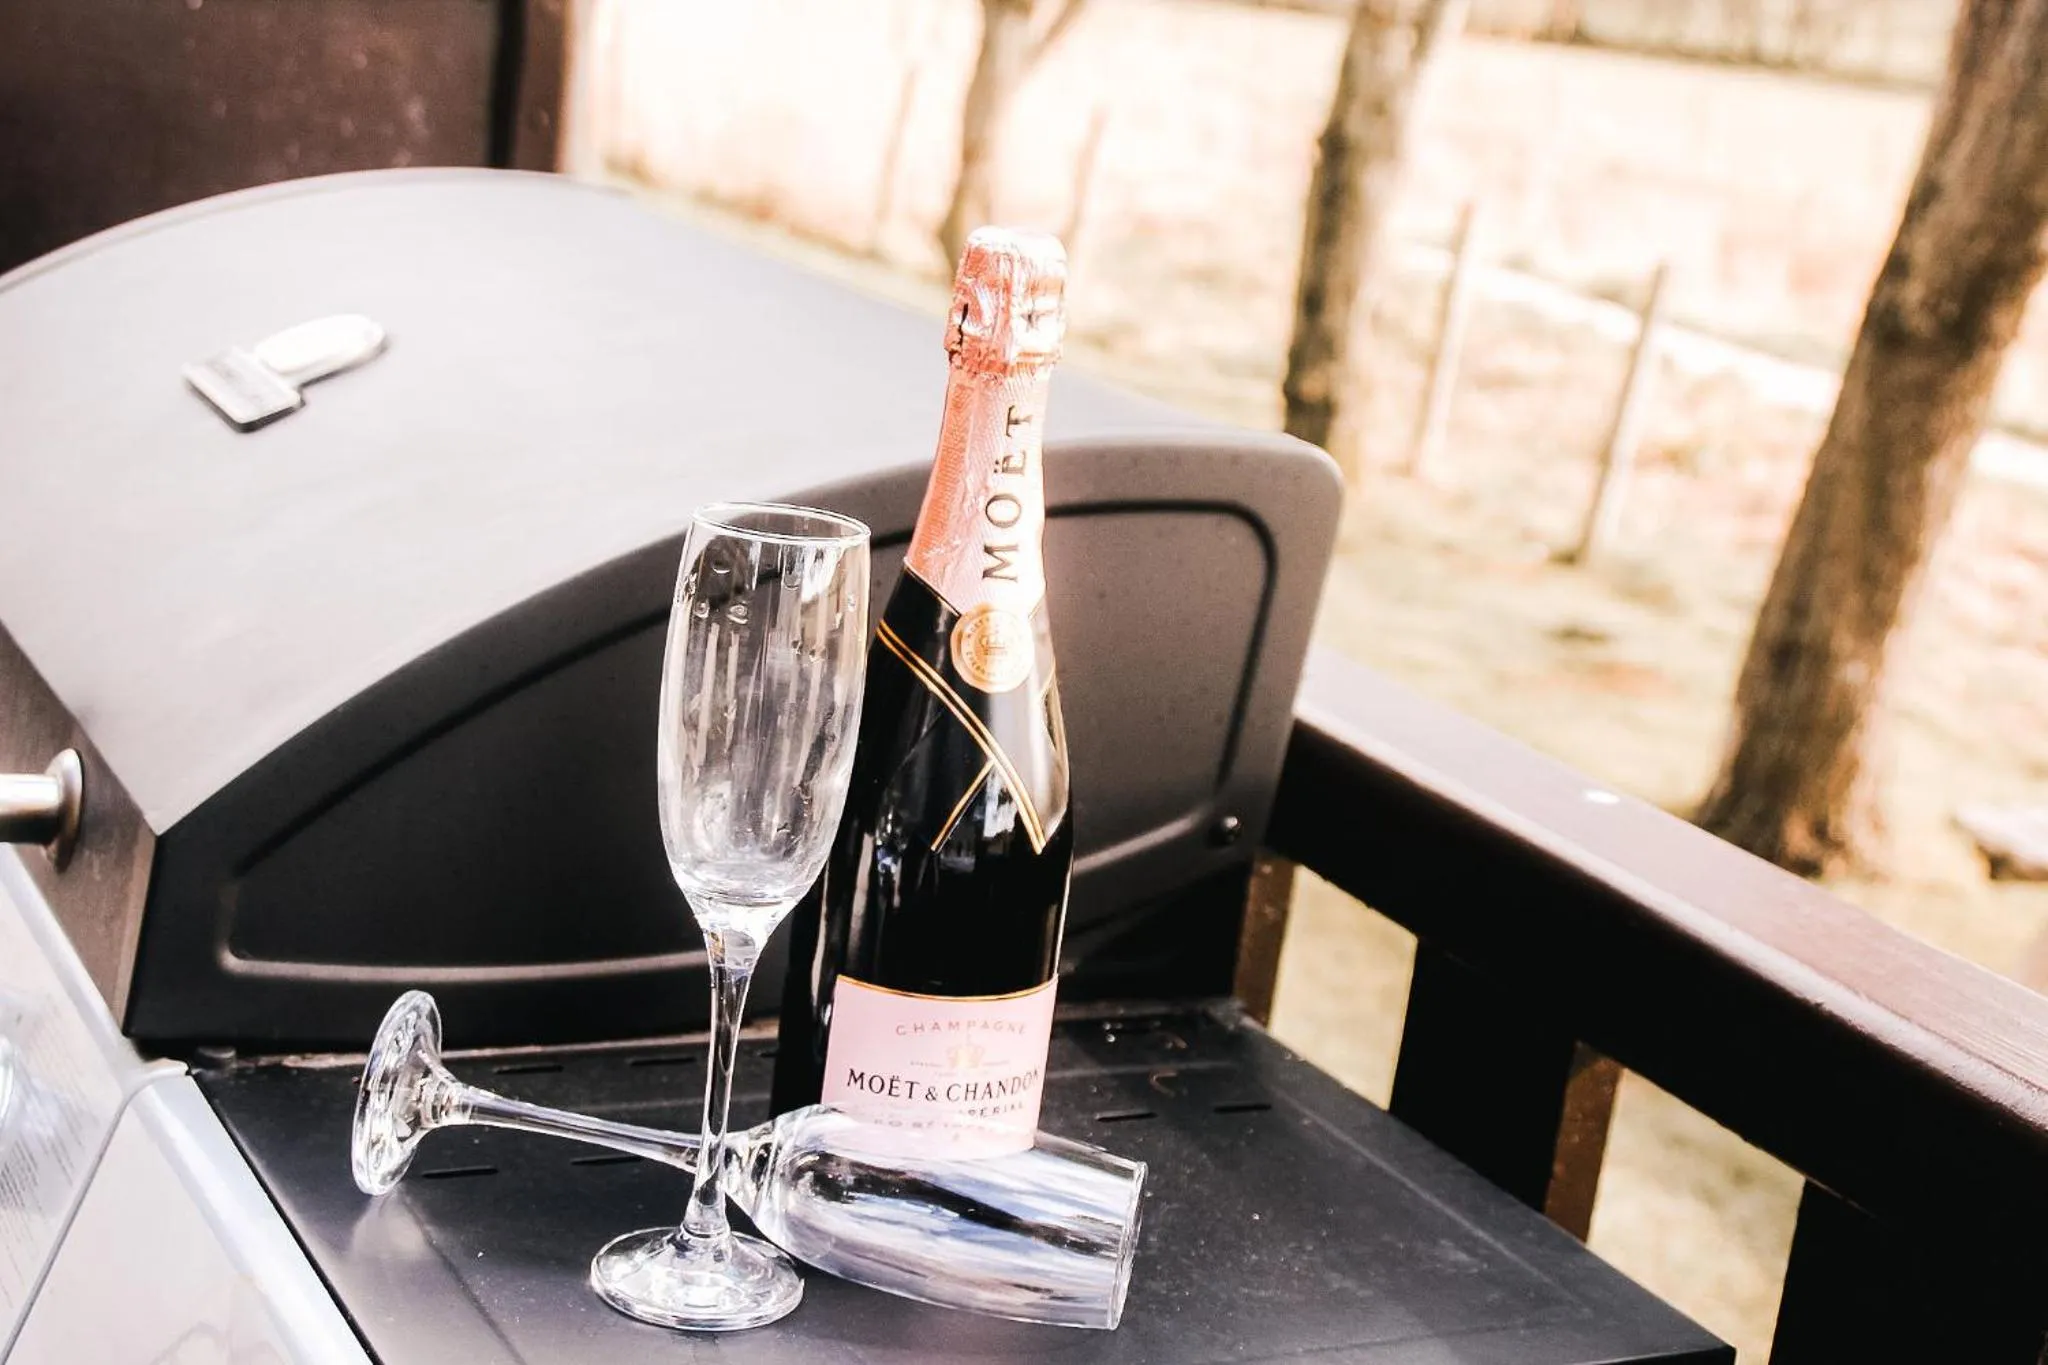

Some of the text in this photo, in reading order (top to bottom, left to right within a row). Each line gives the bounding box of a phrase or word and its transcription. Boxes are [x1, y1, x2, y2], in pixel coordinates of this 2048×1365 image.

[982, 404, 1033, 583] MOËT
[895, 1019, 1027, 1036] CHAMPAGNE
[847, 1068, 921, 1100] MOËT
[925, 1086, 940, 1102] &
